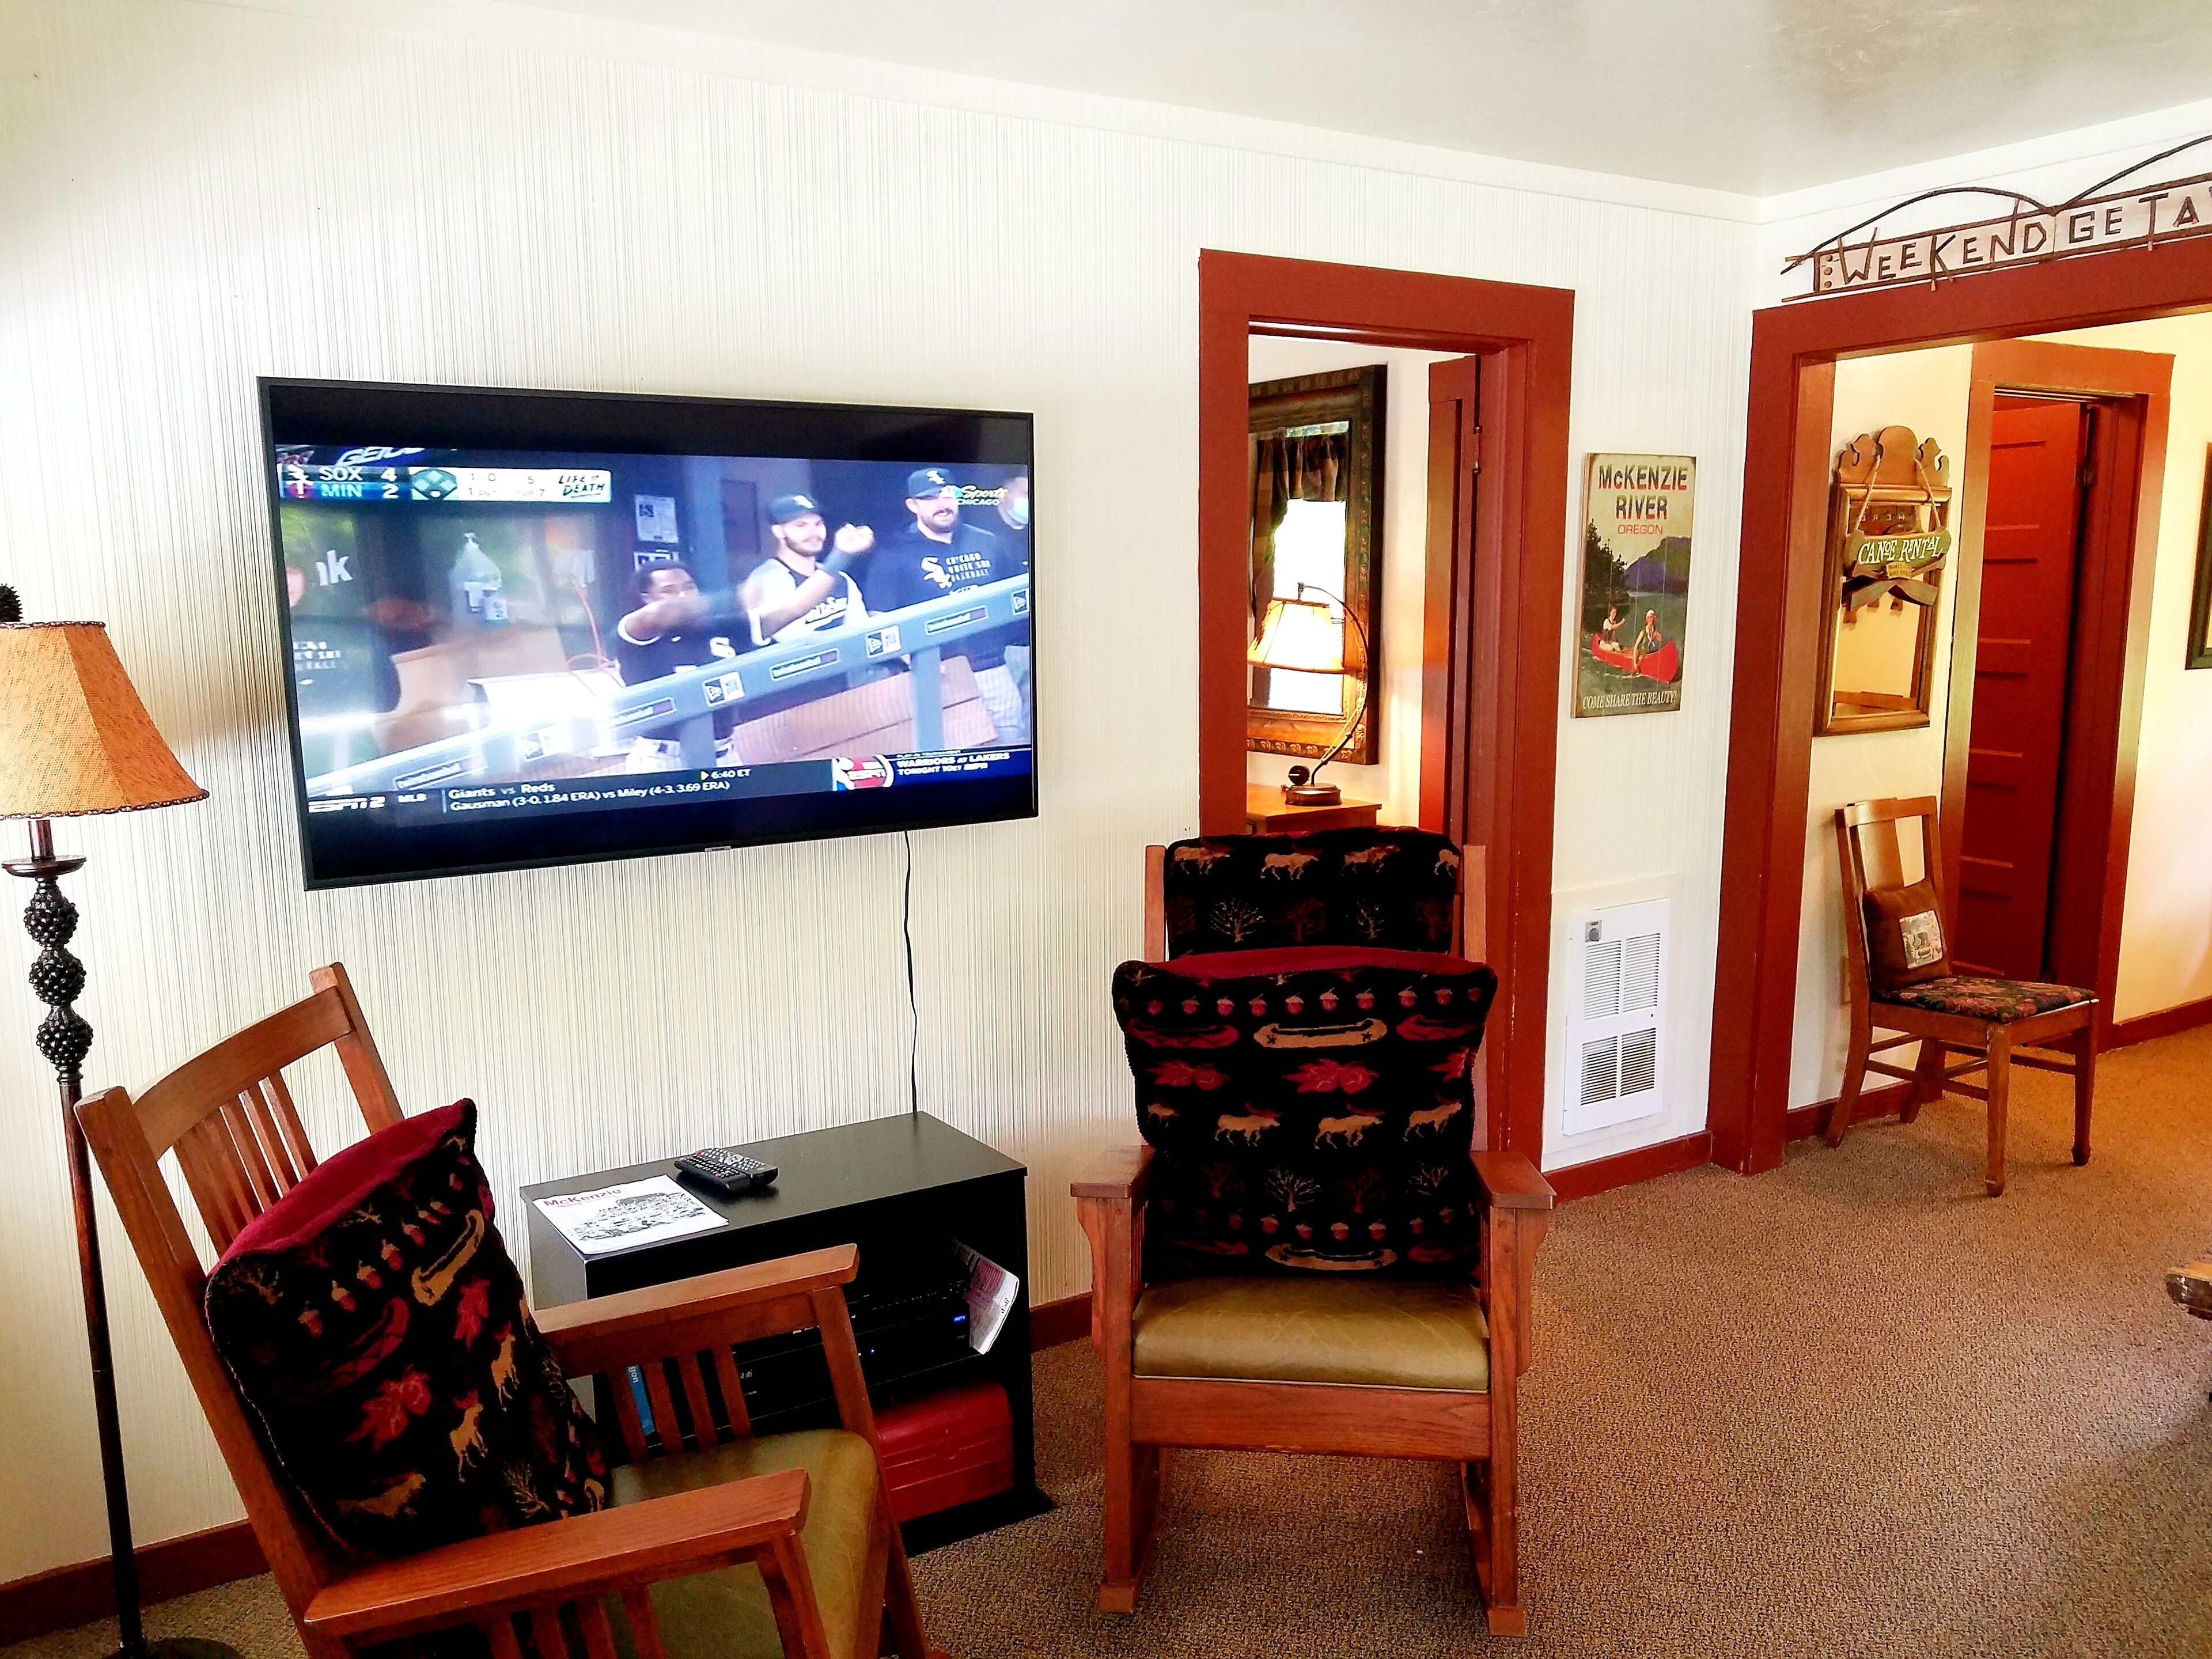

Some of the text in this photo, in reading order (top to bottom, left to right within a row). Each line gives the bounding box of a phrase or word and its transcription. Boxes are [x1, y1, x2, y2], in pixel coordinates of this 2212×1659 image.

[1839, 185, 2212, 291] WEEKEND GETA
[319, 467, 363, 481] SOX
[381, 467, 397, 482] 4
[1599, 464, 1688, 490] McKENZIE
[321, 483, 399, 499] MIN 2
[562, 483, 606, 496] DEATH
[1616, 495, 1668, 519] RIVER
[1618, 524, 1663, 535] OREGON
[1858, 536, 1943, 565] CANOE RENTAL
[1583, 690, 1677, 709] COME SHARE THE BEAUTY!
[969, 752, 1010, 763] LAKERS
[448, 787, 496, 799] Giants
[521, 783, 556, 794] Reds
